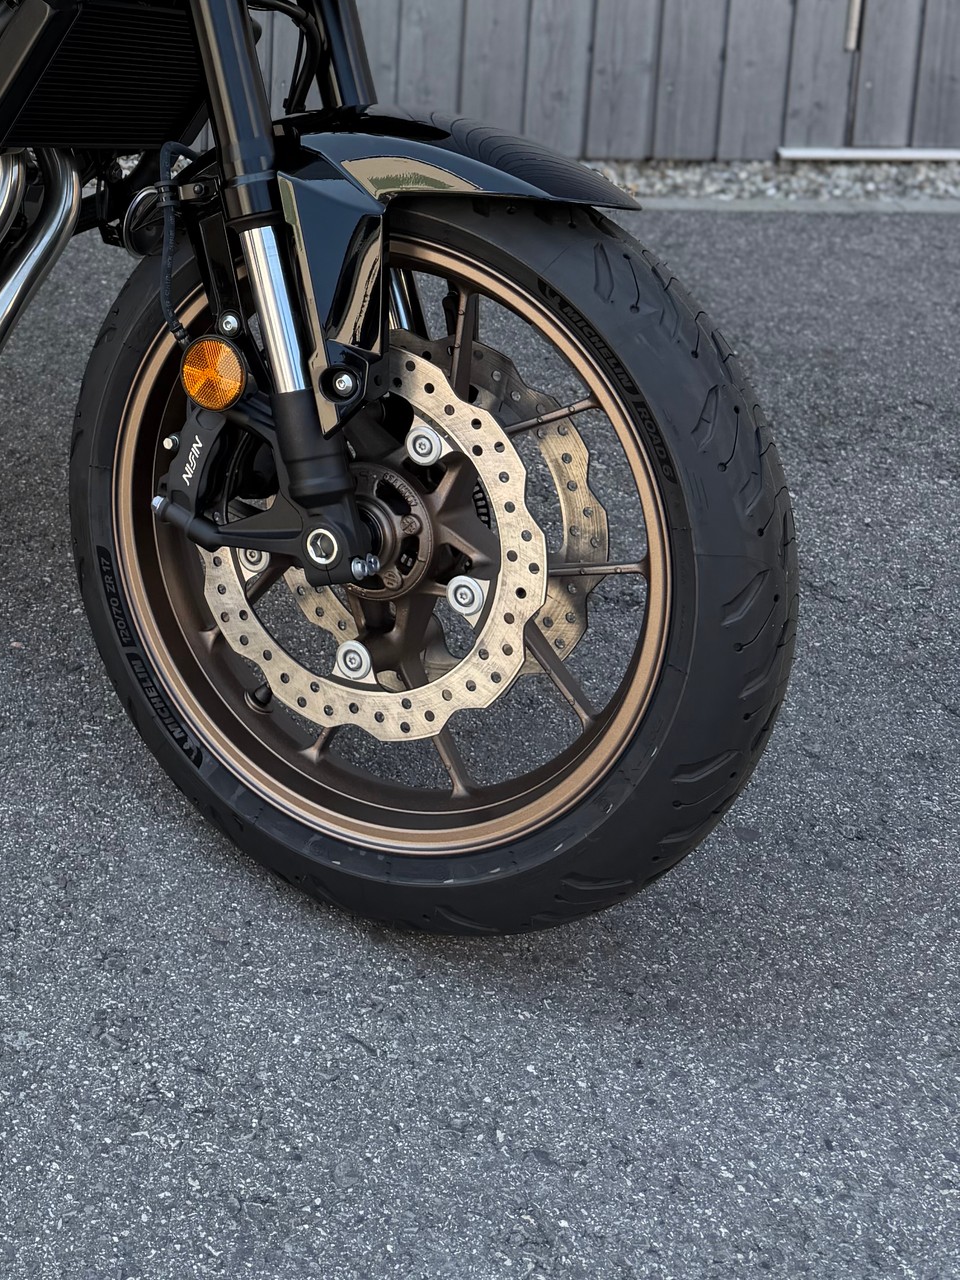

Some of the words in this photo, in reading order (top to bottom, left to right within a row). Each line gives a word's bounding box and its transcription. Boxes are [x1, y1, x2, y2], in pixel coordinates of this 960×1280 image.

[561, 305, 635, 391] MICHELIN
[637, 407, 668, 459] ROAD
[662, 464, 674, 477] 6
[182, 434, 203, 487] NISSIN
[100, 557, 111, 572] 17
[104, 575, 117, 594] ZR
[109, 597, 132, 644] 120/70
[131, 658, 185, 741] MICHELIN
